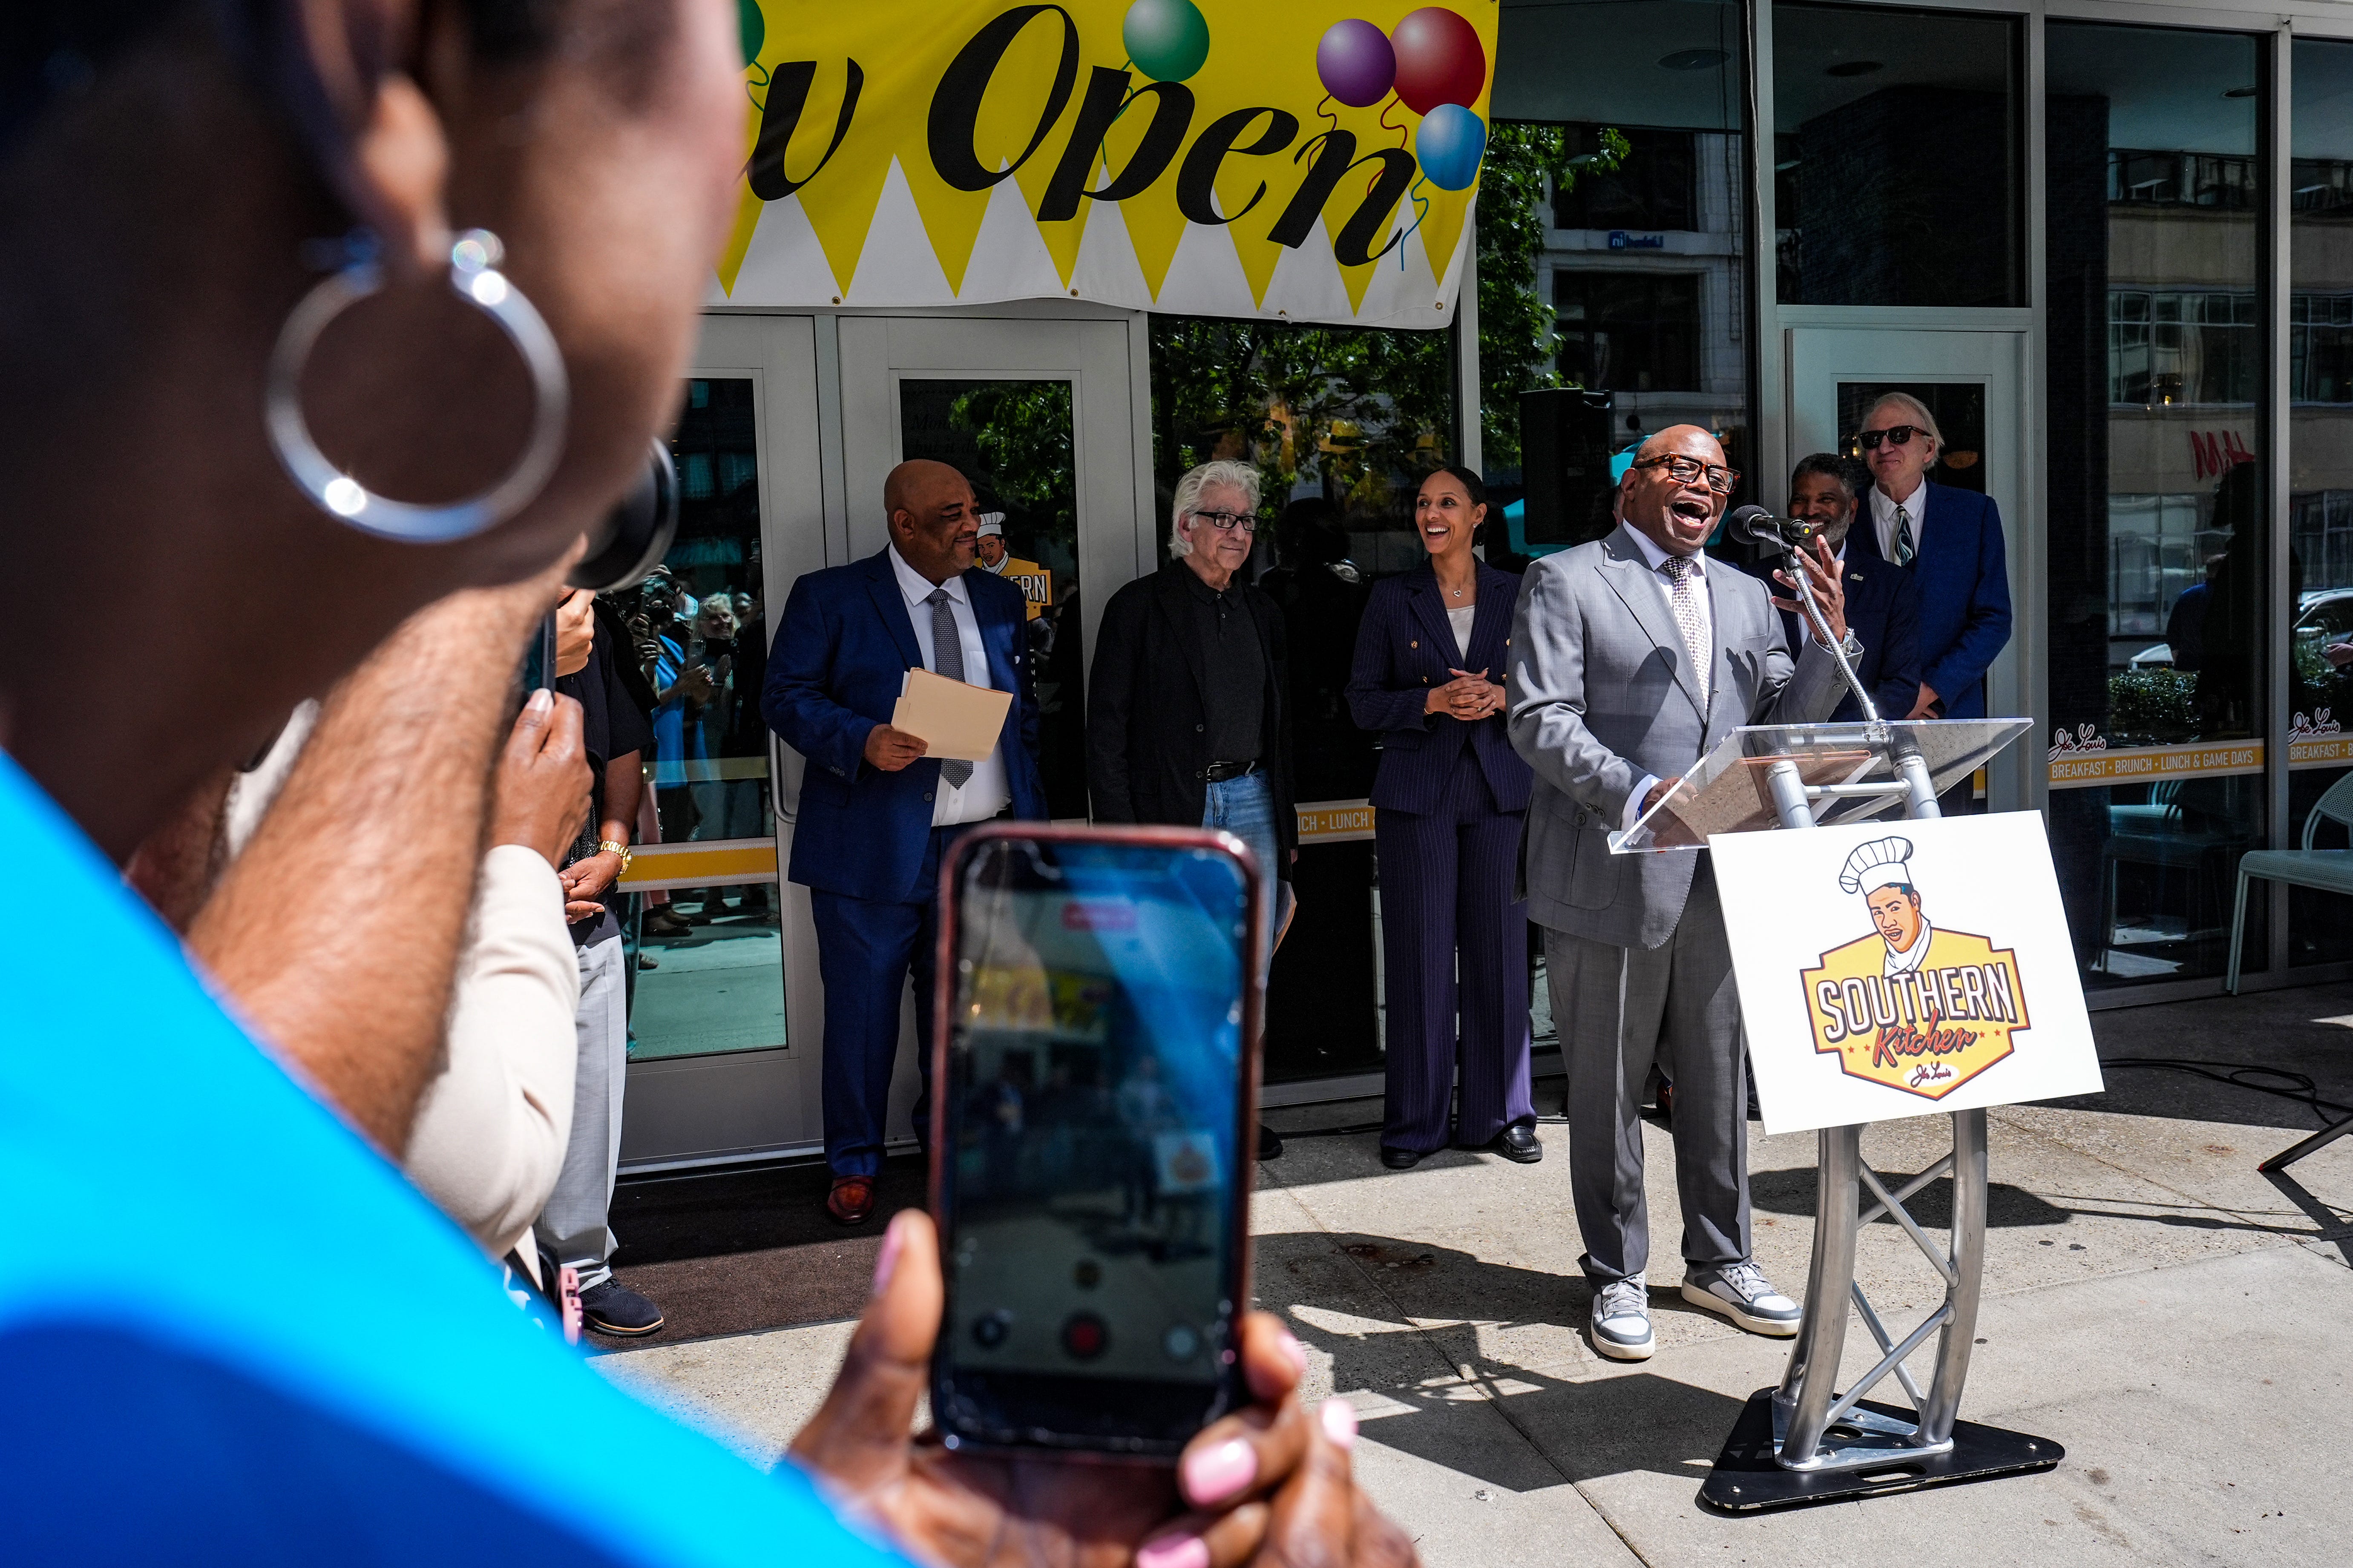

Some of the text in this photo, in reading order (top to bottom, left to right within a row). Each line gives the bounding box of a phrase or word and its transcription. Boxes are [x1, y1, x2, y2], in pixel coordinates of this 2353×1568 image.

[927, 4, 1416, 267] Open
[1003, 575, 1047, 604] RN
[2048, 725, 2106, 763] Joe Louis
[2288, 709, 2339, 744] Joe Louis
[2052, 750, 2253, 778] BREAKFAST BRUNCH LUNCH & GAME DAYS
[2290, 744, 2340, 760] BREAKFAST
[1298, 815, 1317, 832] CH
[1329, 812, 1369, 830] LUNCH
[1816, 962, 2018, 1042] SOUTHERN
[1873, 1008, 1977, 1068] Kitchen
